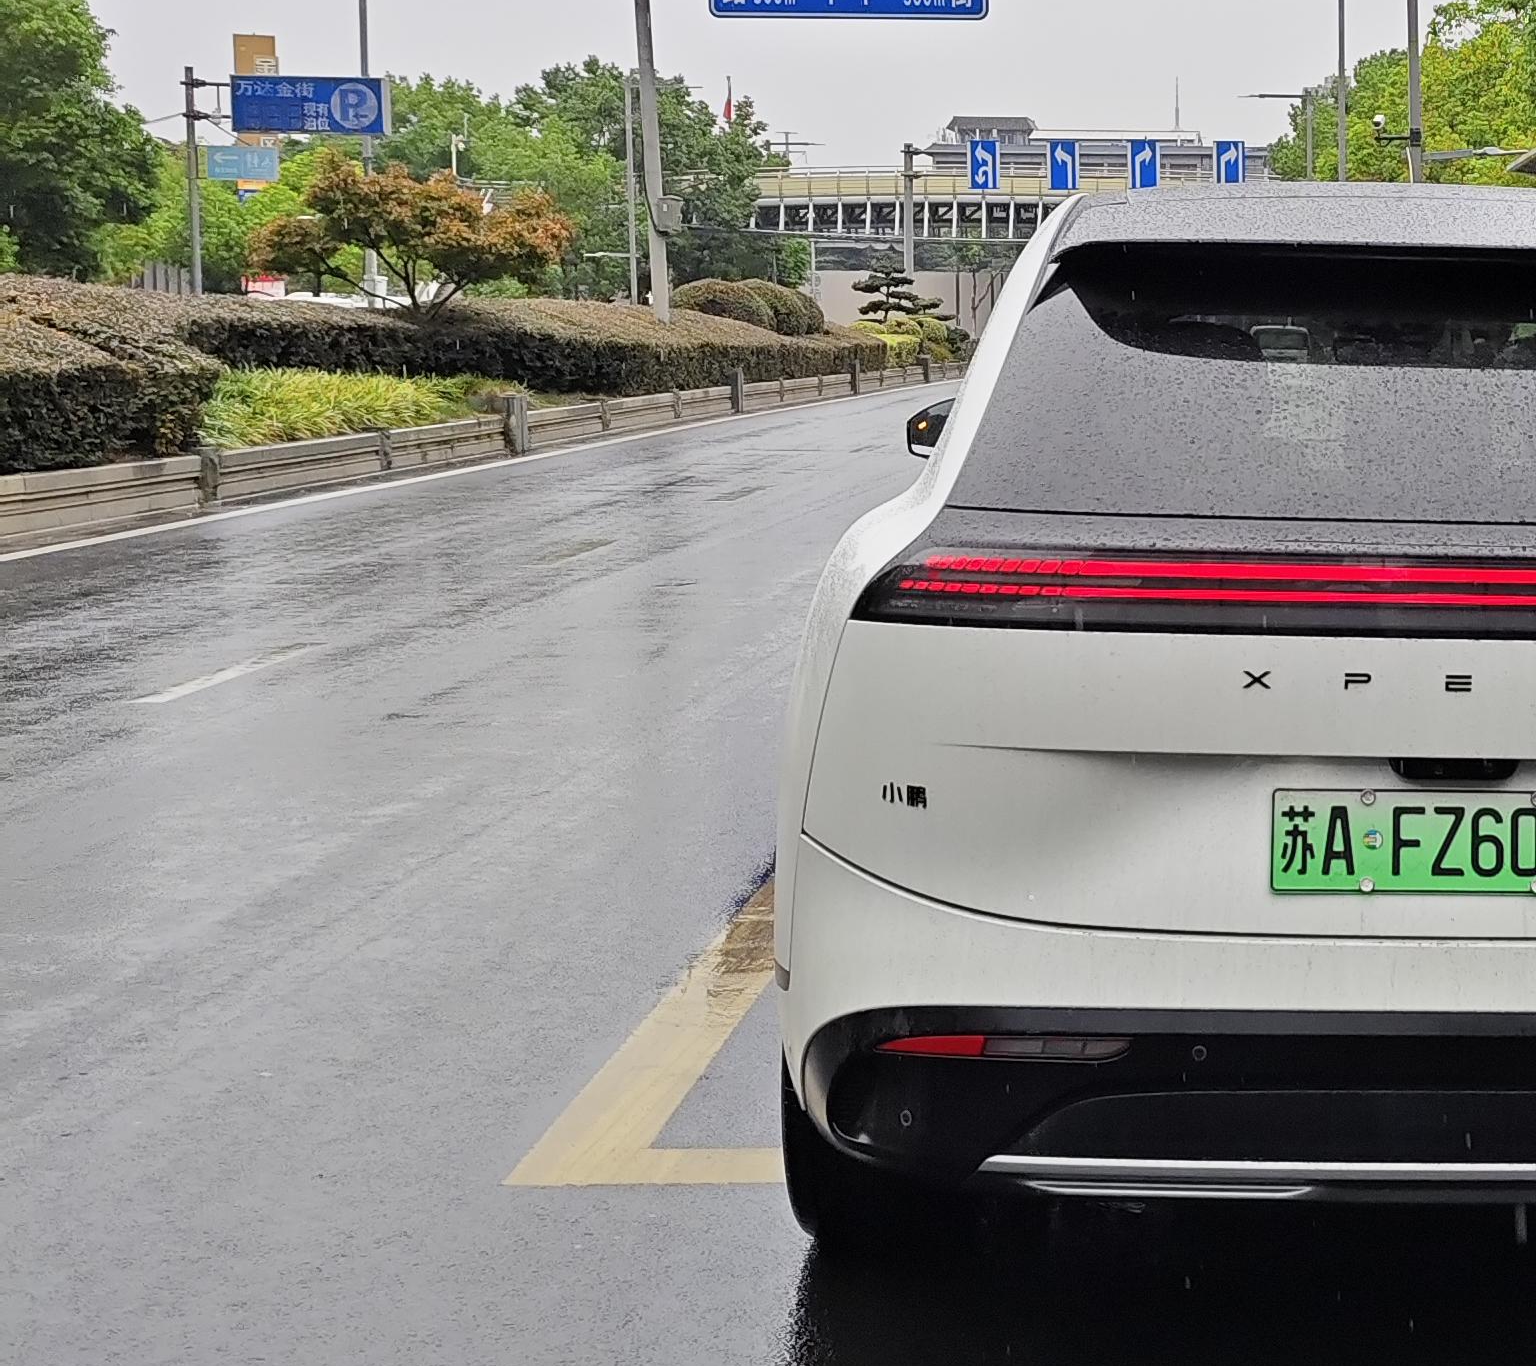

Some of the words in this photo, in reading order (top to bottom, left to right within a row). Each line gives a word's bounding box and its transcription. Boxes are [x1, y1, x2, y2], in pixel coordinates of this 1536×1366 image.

[236, 80, 315, 98] 万达金街
[881, 781, 928, 809] 小鹏
